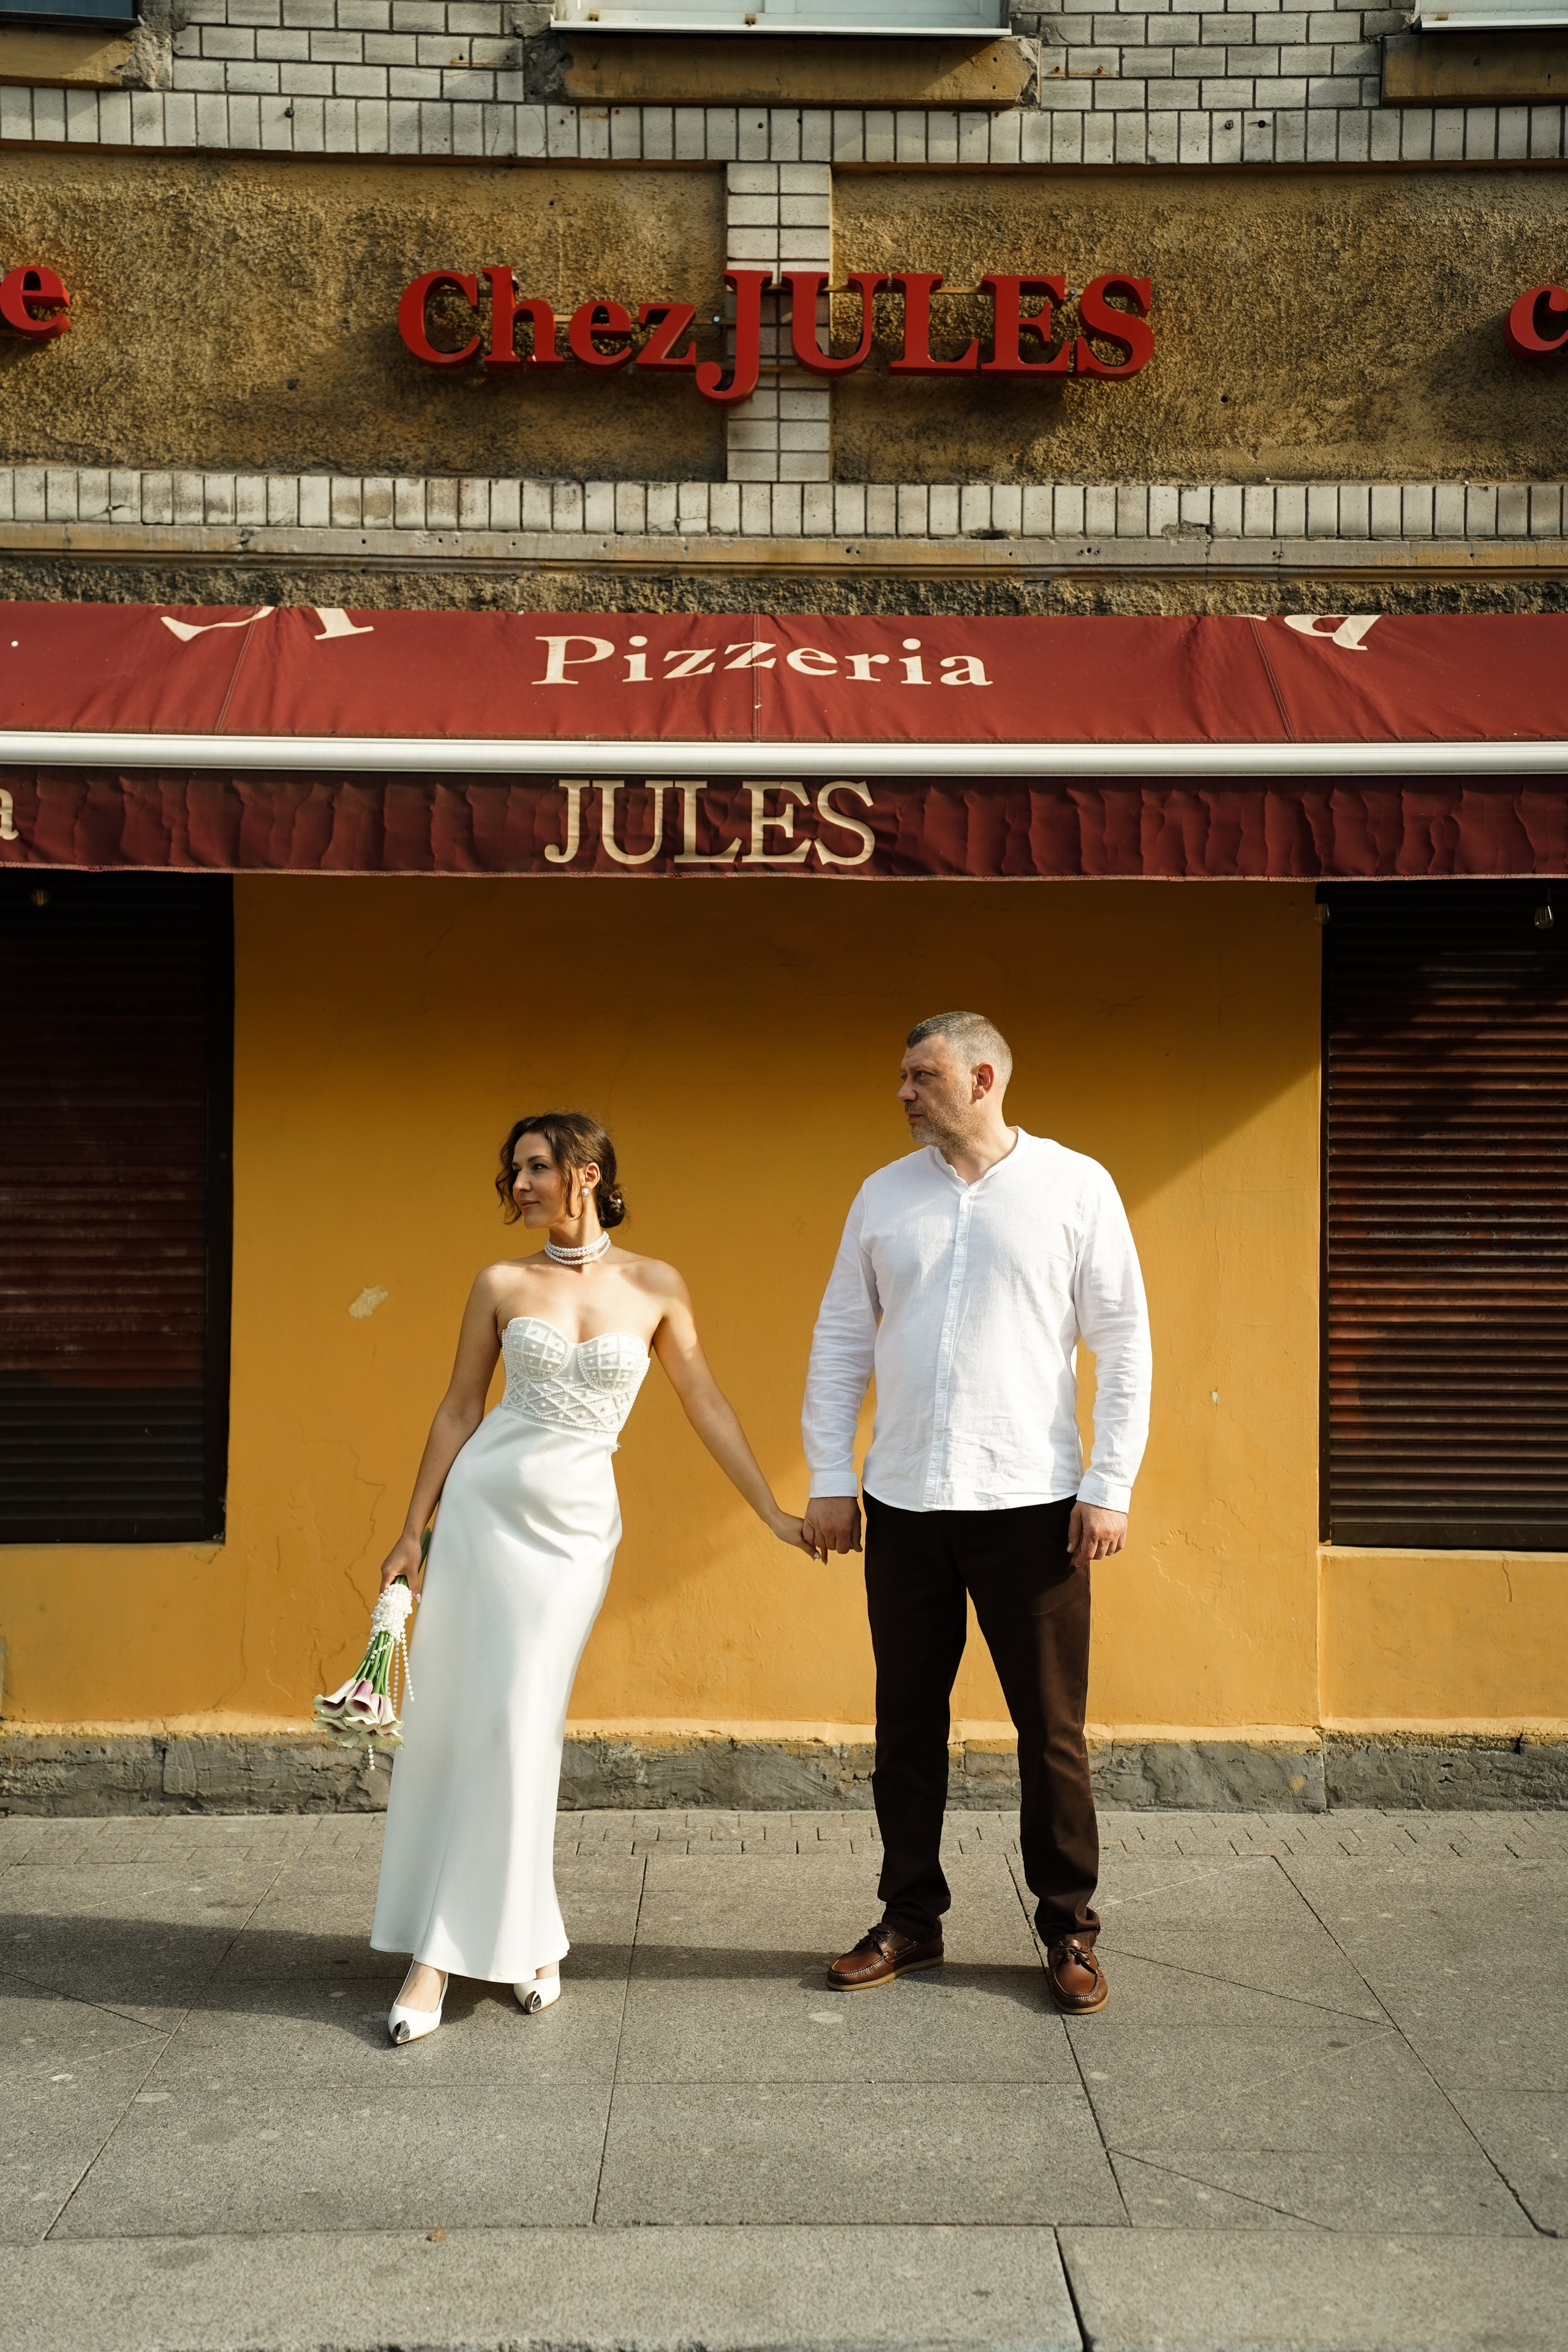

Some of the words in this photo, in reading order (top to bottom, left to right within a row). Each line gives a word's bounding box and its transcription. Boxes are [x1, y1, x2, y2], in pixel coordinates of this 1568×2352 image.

[696, 269, 1155, 406] JULES
[531, 635, 993, 686] Pizzeria
[545, 779, 875, 865] JULES
